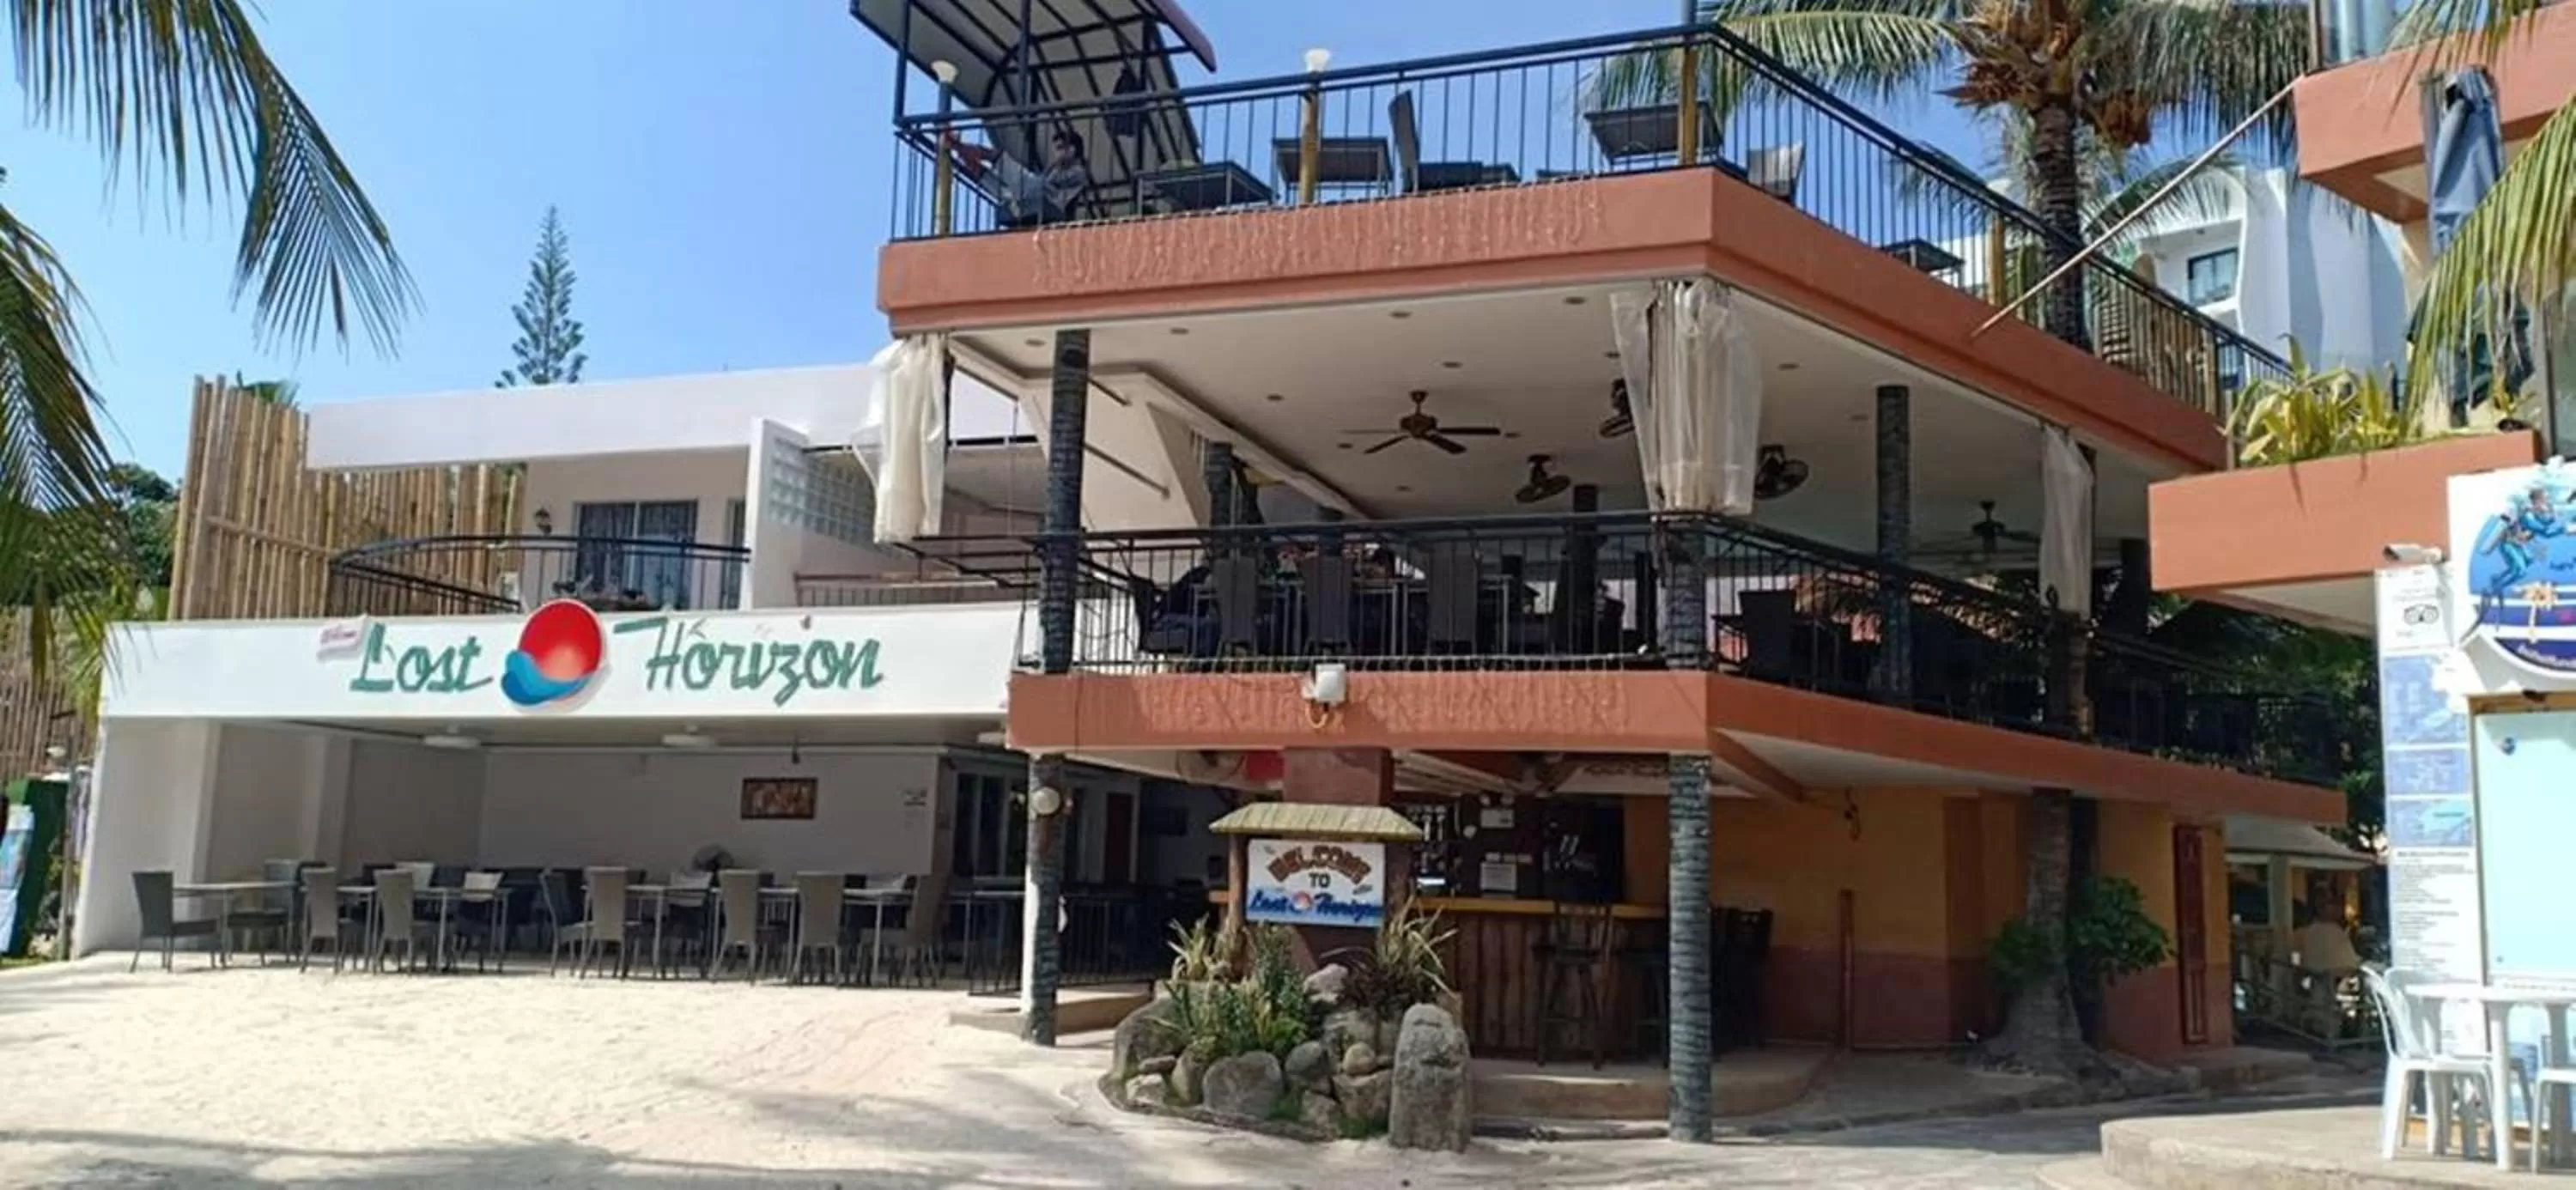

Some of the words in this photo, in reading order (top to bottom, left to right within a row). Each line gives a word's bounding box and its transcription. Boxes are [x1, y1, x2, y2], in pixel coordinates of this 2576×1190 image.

[349, 622, 494, 693] Lost
[613, 616, 884, 707] Horizon
[1267, 845, 1372, 885] WELCOME
[1309, 872, 1331, 888] TO
[1249, 889, 1288, 912] Lost
